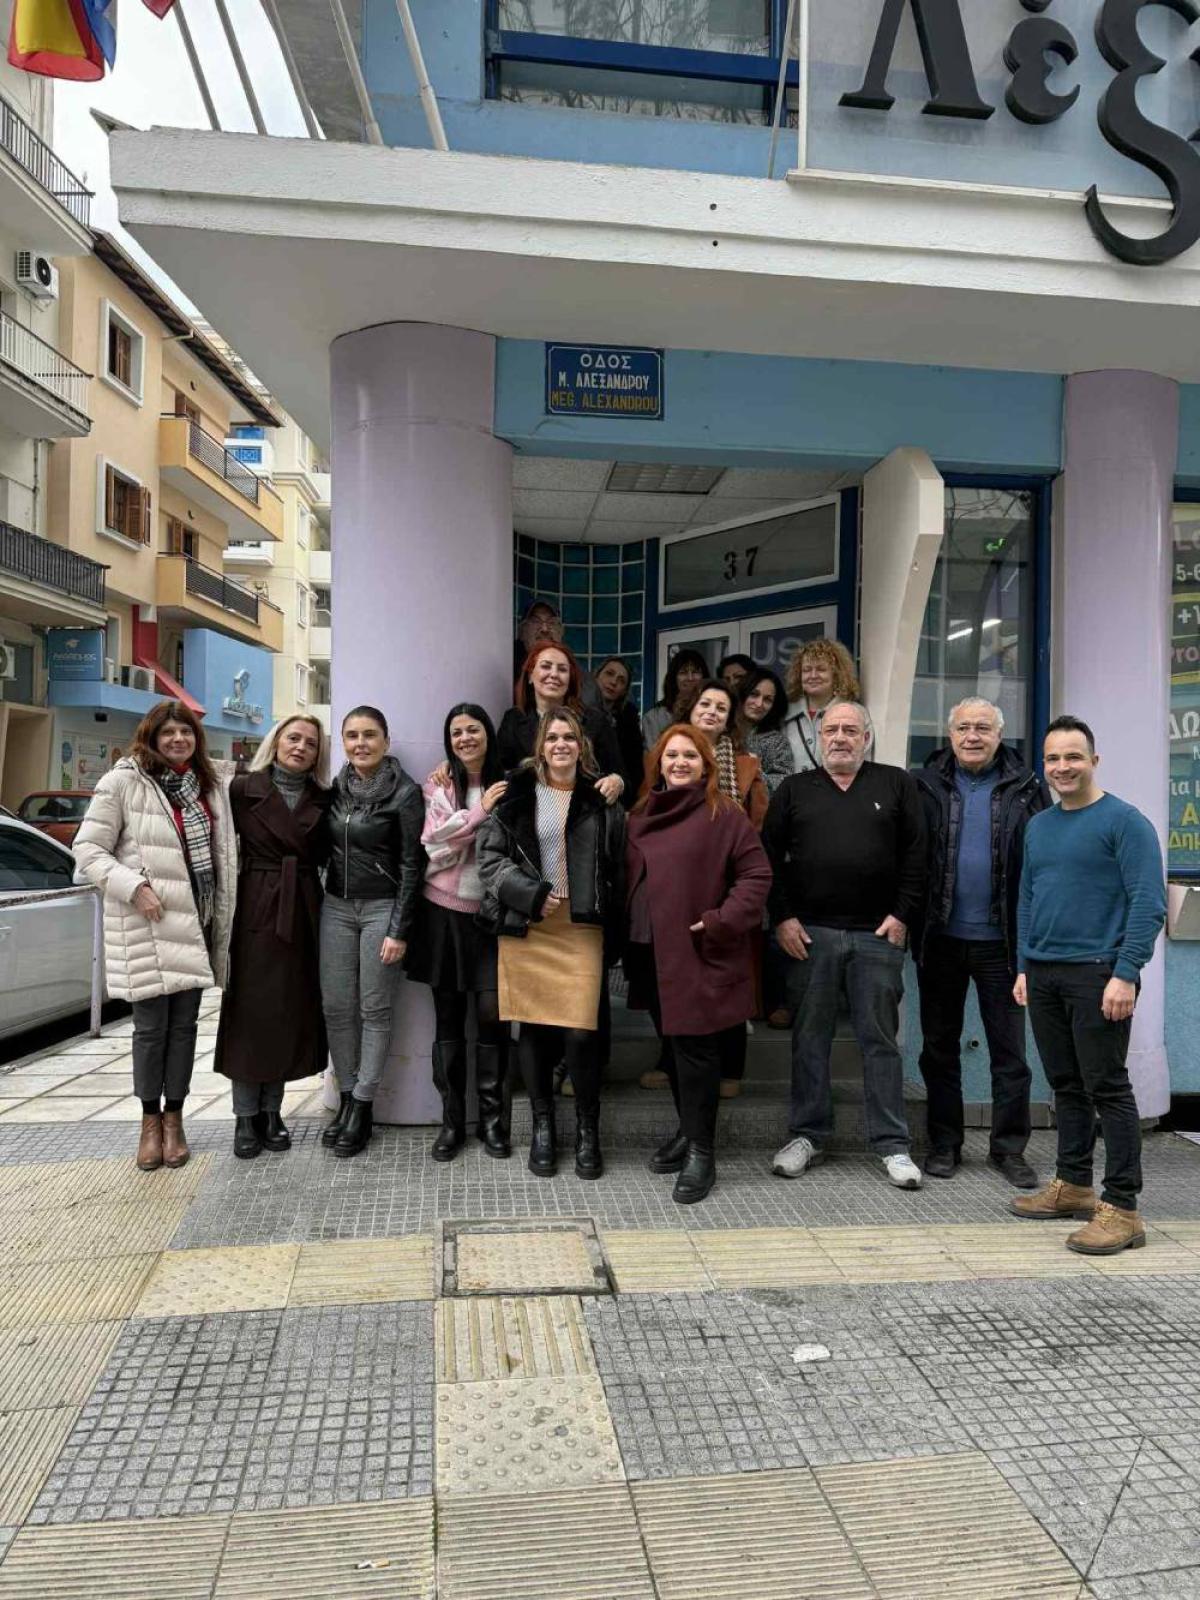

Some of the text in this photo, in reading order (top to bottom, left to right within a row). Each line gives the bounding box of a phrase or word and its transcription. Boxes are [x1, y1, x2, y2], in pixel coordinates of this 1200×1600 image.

[580, 353, 632, 370] ΟΔΟΣ
[576, 372, 650, 391] ΑΛΕΞΑΝΔΡΟΥ
[582, 392, 657, 412] ALEXANDROU
[723, 546, 759, 580] 37
